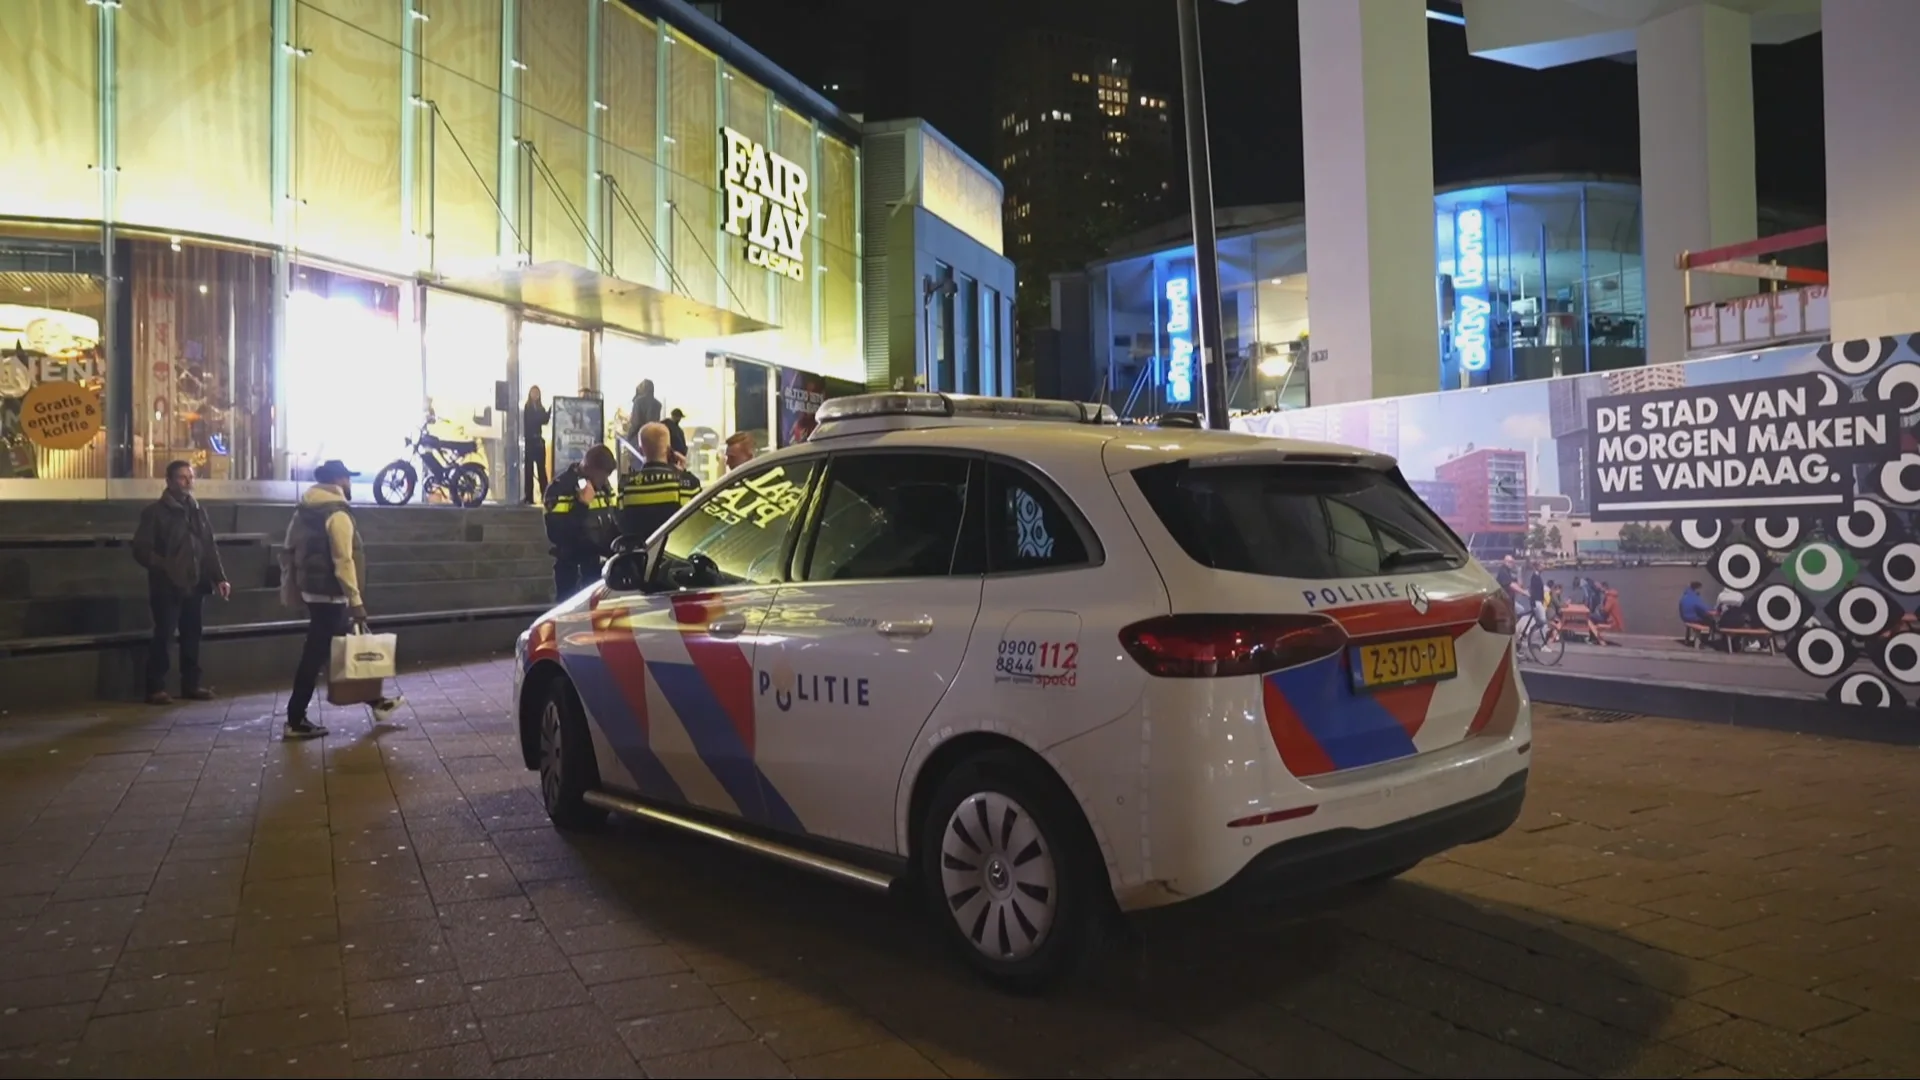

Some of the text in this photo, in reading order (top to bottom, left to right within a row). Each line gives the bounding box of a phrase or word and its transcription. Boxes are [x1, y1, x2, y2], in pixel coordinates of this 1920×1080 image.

[723, 126, 808, 215] FAIR
[723, 178, 809, 262] PLAY
[747, 243, 804, 282] CASINO
[1455, 296, 1490, 370] city
[28, 410, 79, 429] entree
[34, 395, 82, 414] Gratis
[1597, 387, 1806, 433] DE STAD VAN
[42, 420, 88, 438] koffie
[1597, 414, 1886, 463] MORGEN MAKEN
[1597, 465, 1643, 492] WE
[1652, 453, 1841, 490] VANDAAG.
[1302, 582, 1400, 607] POLITIE
[996, 656, 1033, 672] 8844
[998, 640, 1079, 669] 0900 112
[1371, 640, 1447, 680] Z-370-PJ
